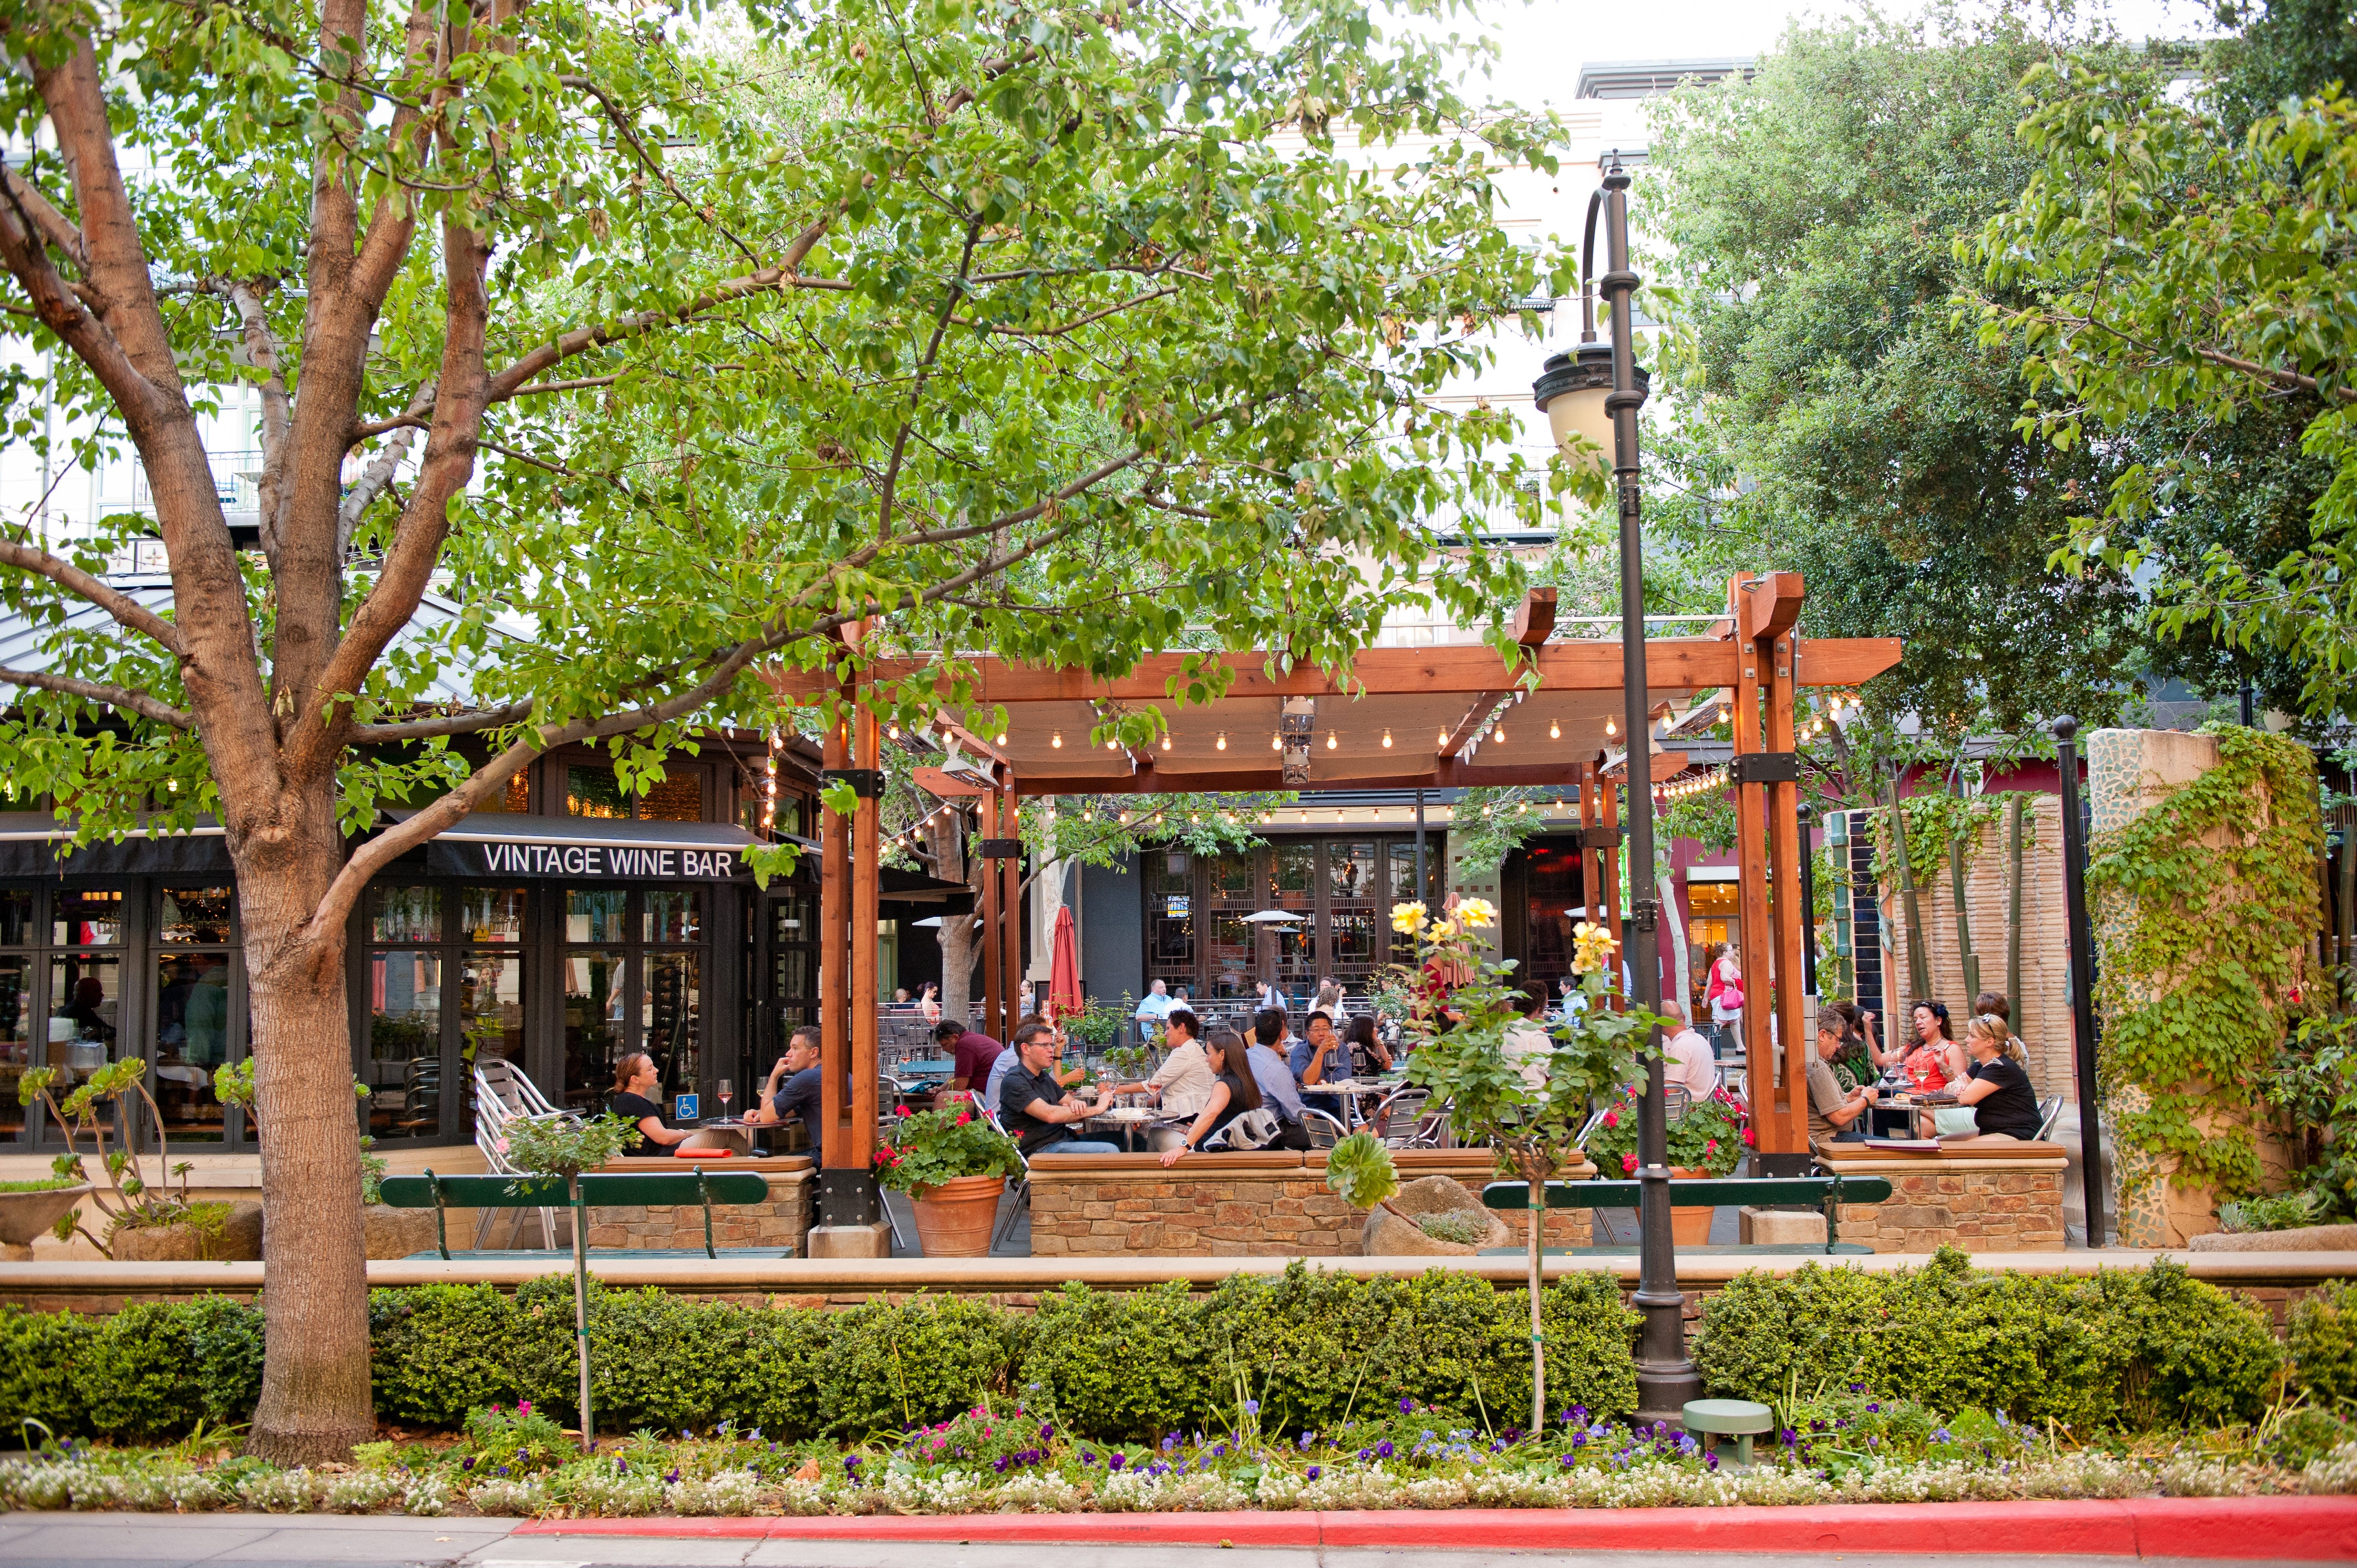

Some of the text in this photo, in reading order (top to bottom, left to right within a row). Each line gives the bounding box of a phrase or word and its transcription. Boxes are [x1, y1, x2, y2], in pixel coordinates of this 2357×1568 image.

[483, 844, 732, 877] VINTAGE WINE BAR
